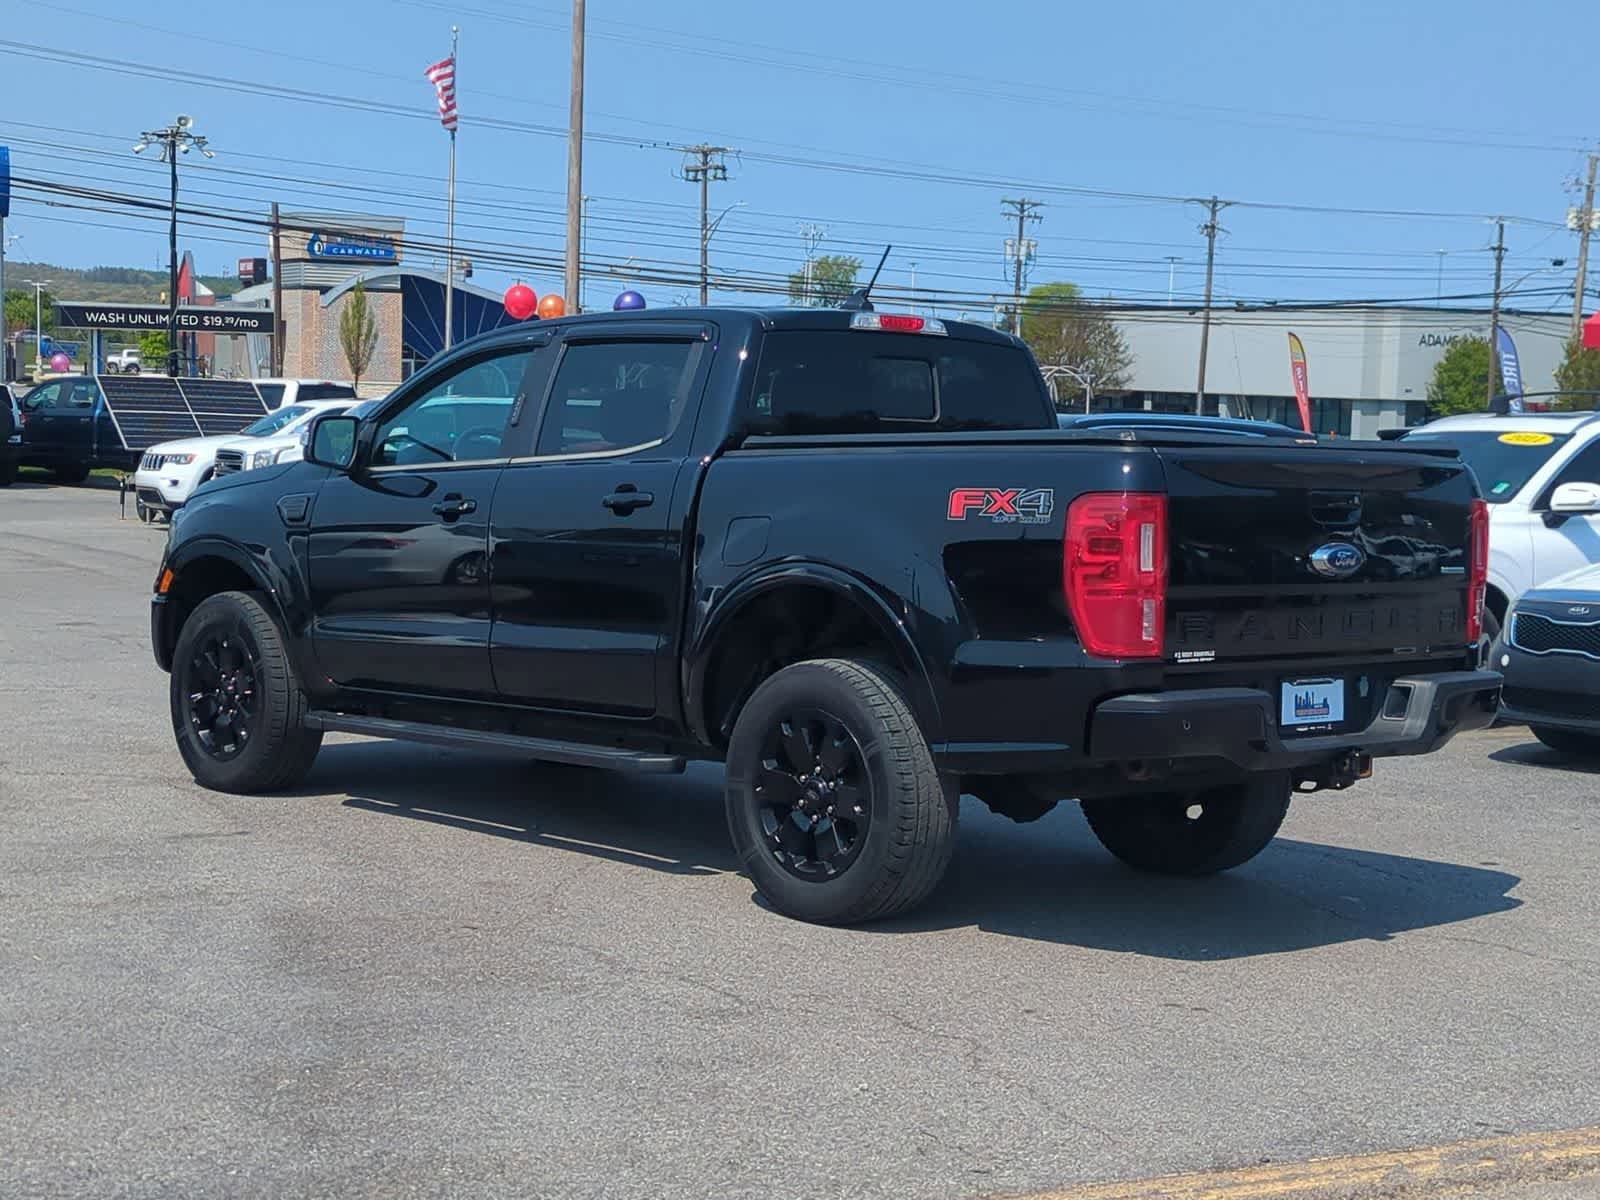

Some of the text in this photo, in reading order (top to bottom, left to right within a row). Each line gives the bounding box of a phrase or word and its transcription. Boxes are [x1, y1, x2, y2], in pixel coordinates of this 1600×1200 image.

[85, 312, 125, 323] WASH
[129, 313, 198, 325] UNLIMTED
[947, 488, 1054, 520] FX4
